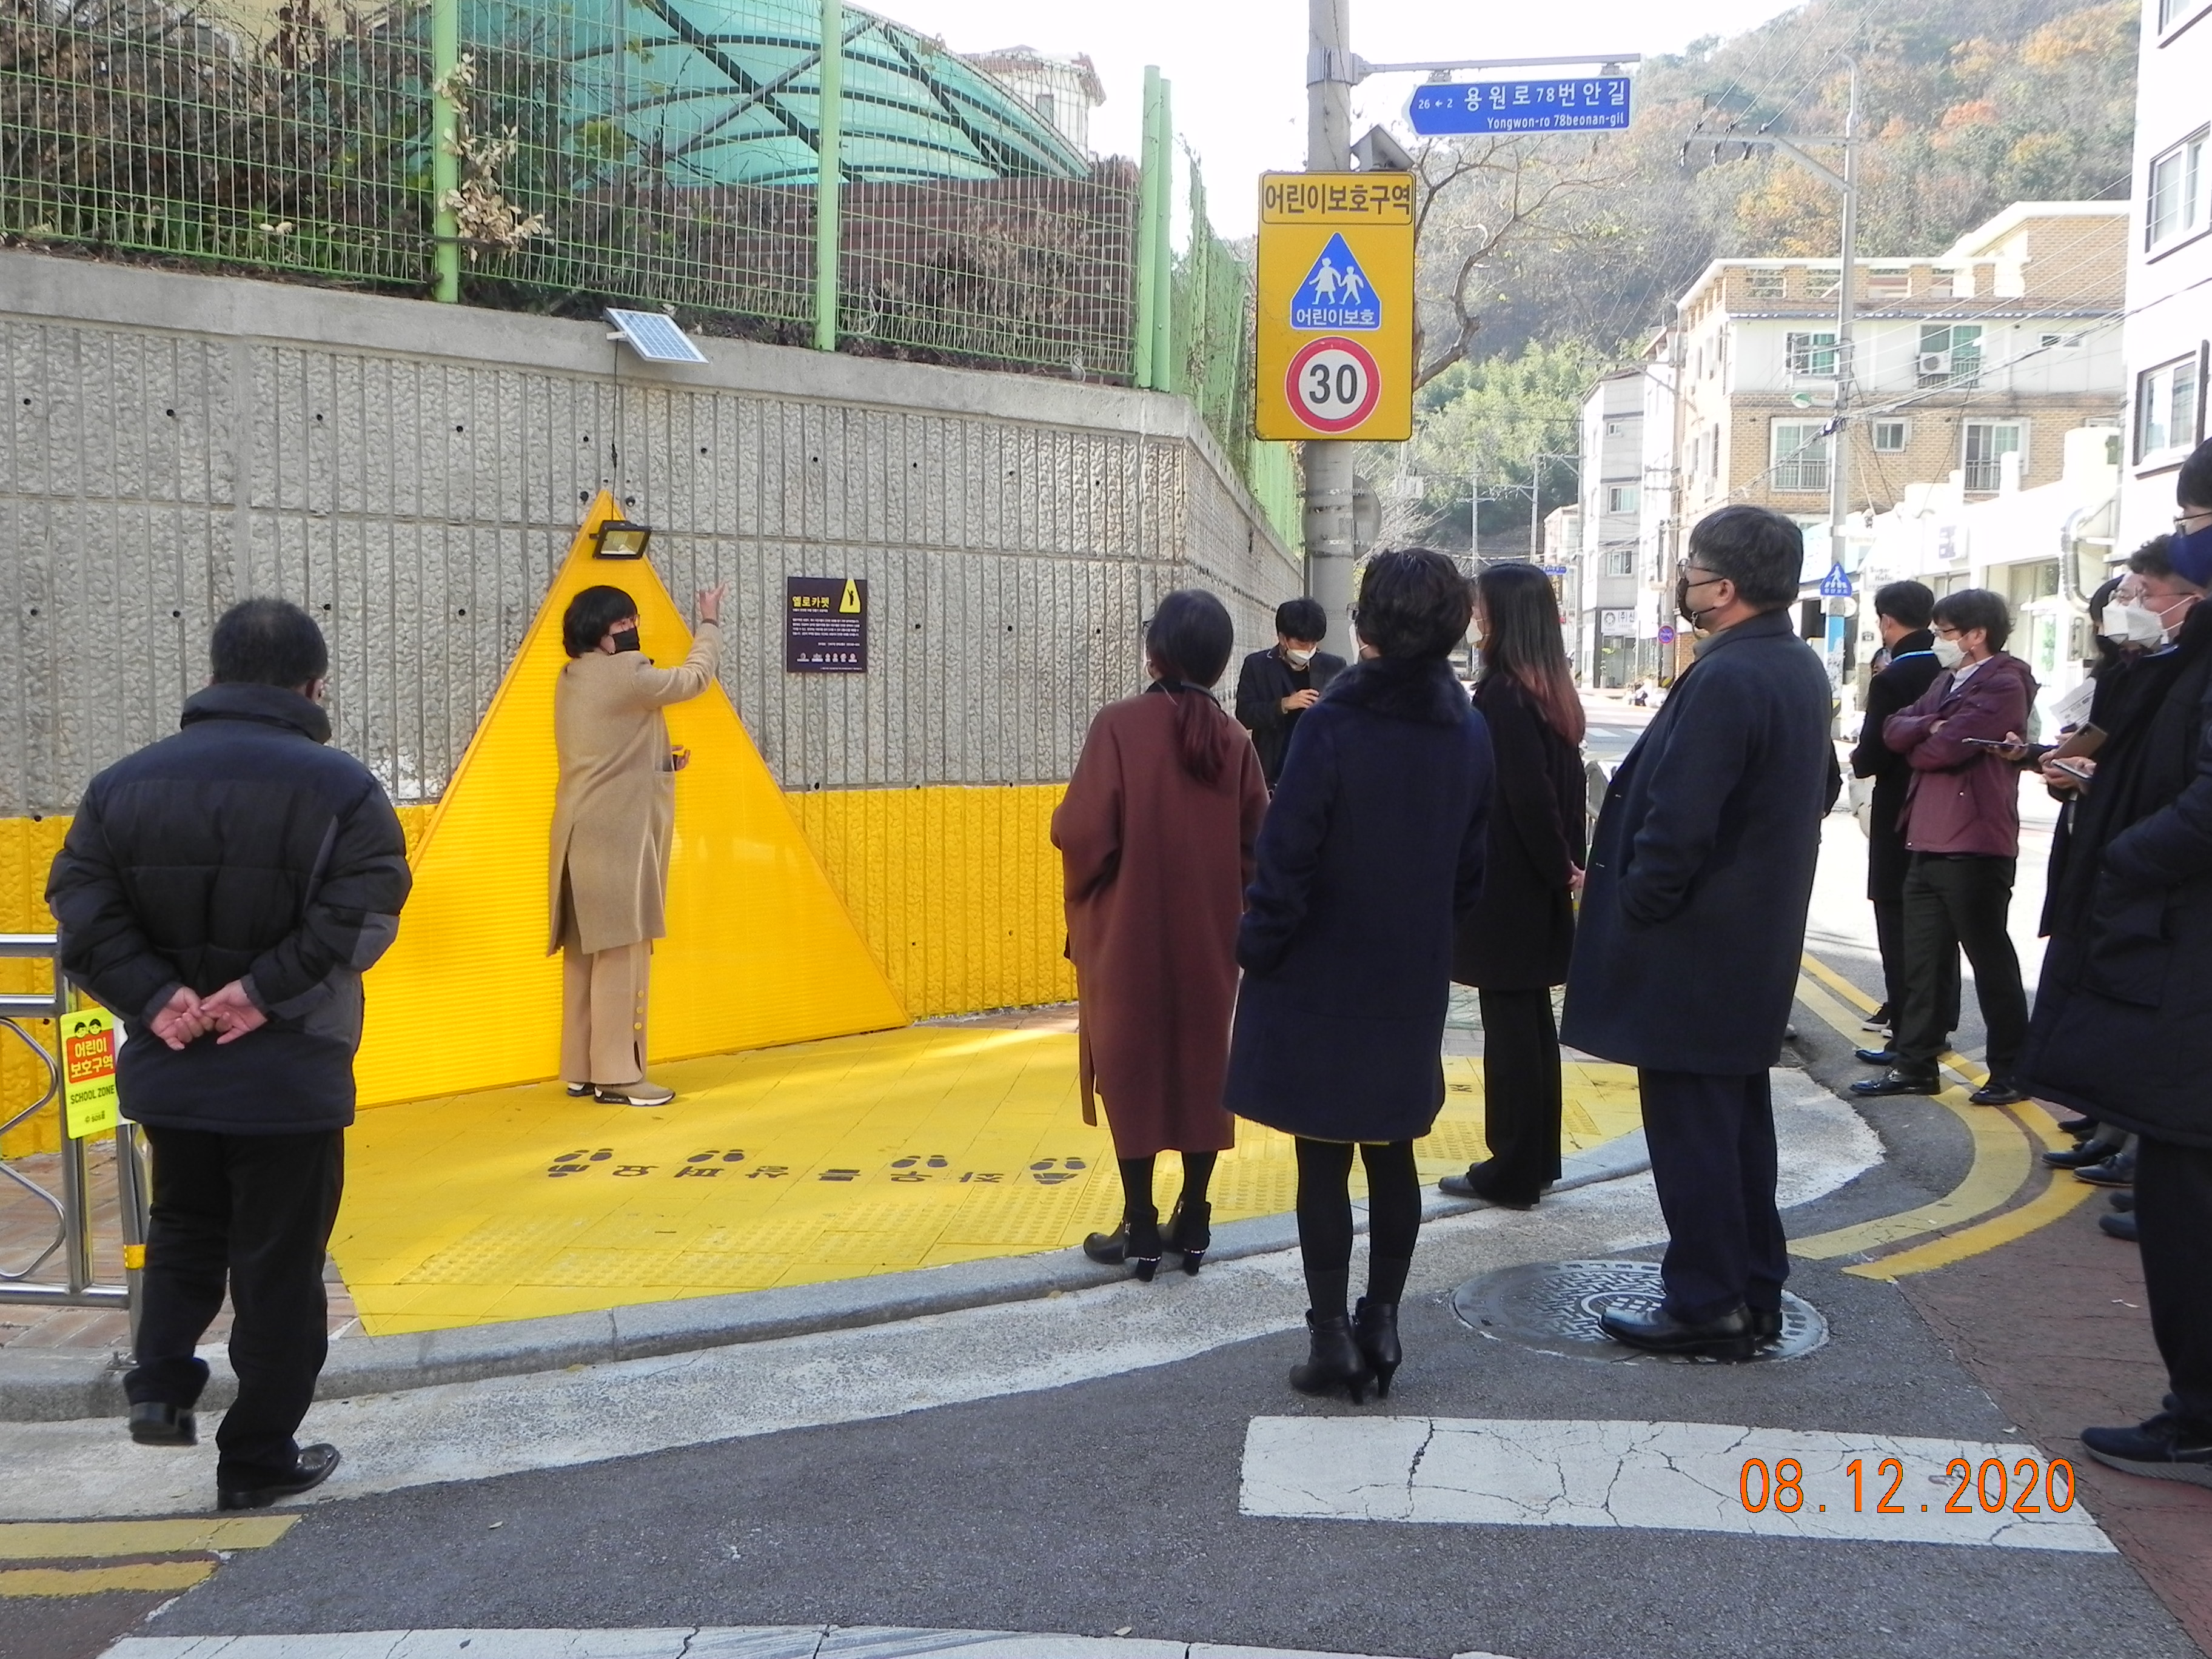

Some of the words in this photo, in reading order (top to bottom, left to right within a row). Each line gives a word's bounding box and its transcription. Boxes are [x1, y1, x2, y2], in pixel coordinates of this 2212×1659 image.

[1418, 99, 1430, 110] 26
[1447, 98, 1453, 109] 2
[1487, 117, 1550, 132] Yongwon-ro
[1553, 112, 1624, 129] 78beonan-gil
[1265, 183, 1411, 216] 어린이보호구역
[1296, 309, 1375, 326] 어린이보호
[1309, 363, 1358, 404] 30
[792, 596, 830, 608] 옐로카펫
[75, 1037, 107, 1057] 어린이
[71, 1054, 113, 1078] 보호구역
[70, 1090, 96, 1104] SCHOOL
[98, 1084, 115, 1099] ZONE
